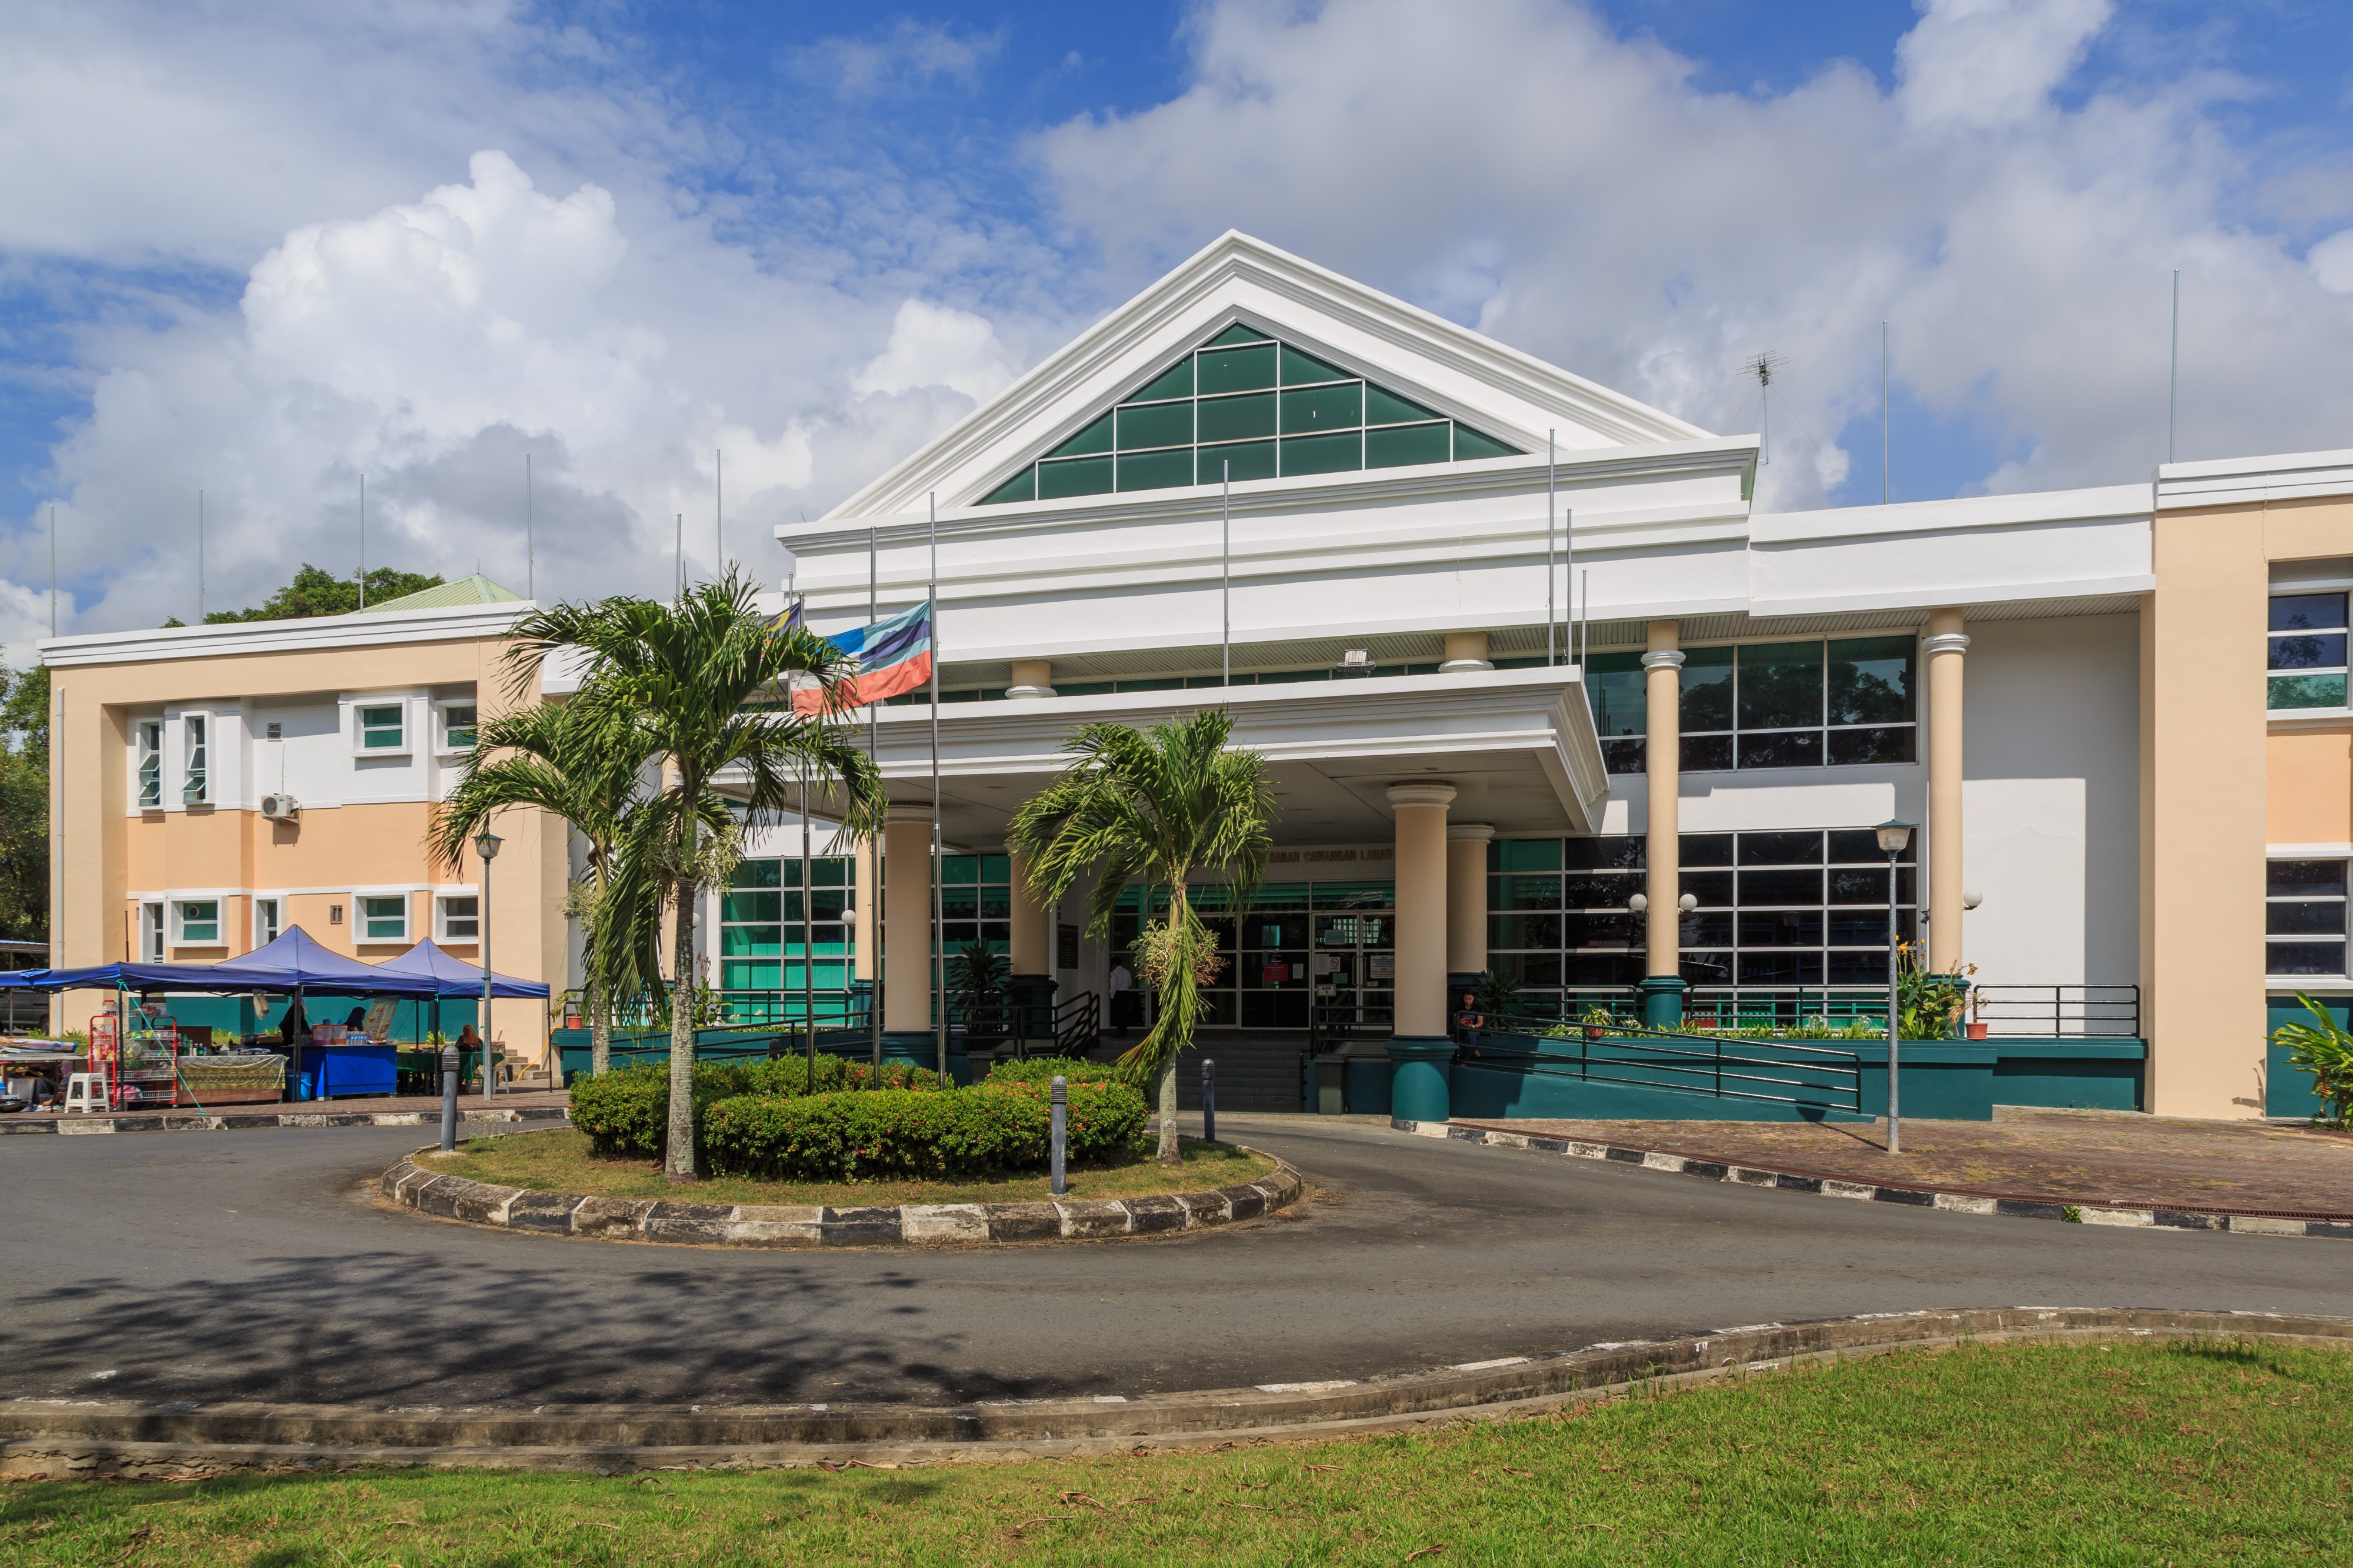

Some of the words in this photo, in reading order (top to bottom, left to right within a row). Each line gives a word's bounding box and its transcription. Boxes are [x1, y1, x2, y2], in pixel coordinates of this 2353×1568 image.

[1269, 851, 1300, 863] SABAH
[1304, 850, 1357, 863] CAWANGAN
[1360, 849, 1394, 860] LAHAD
